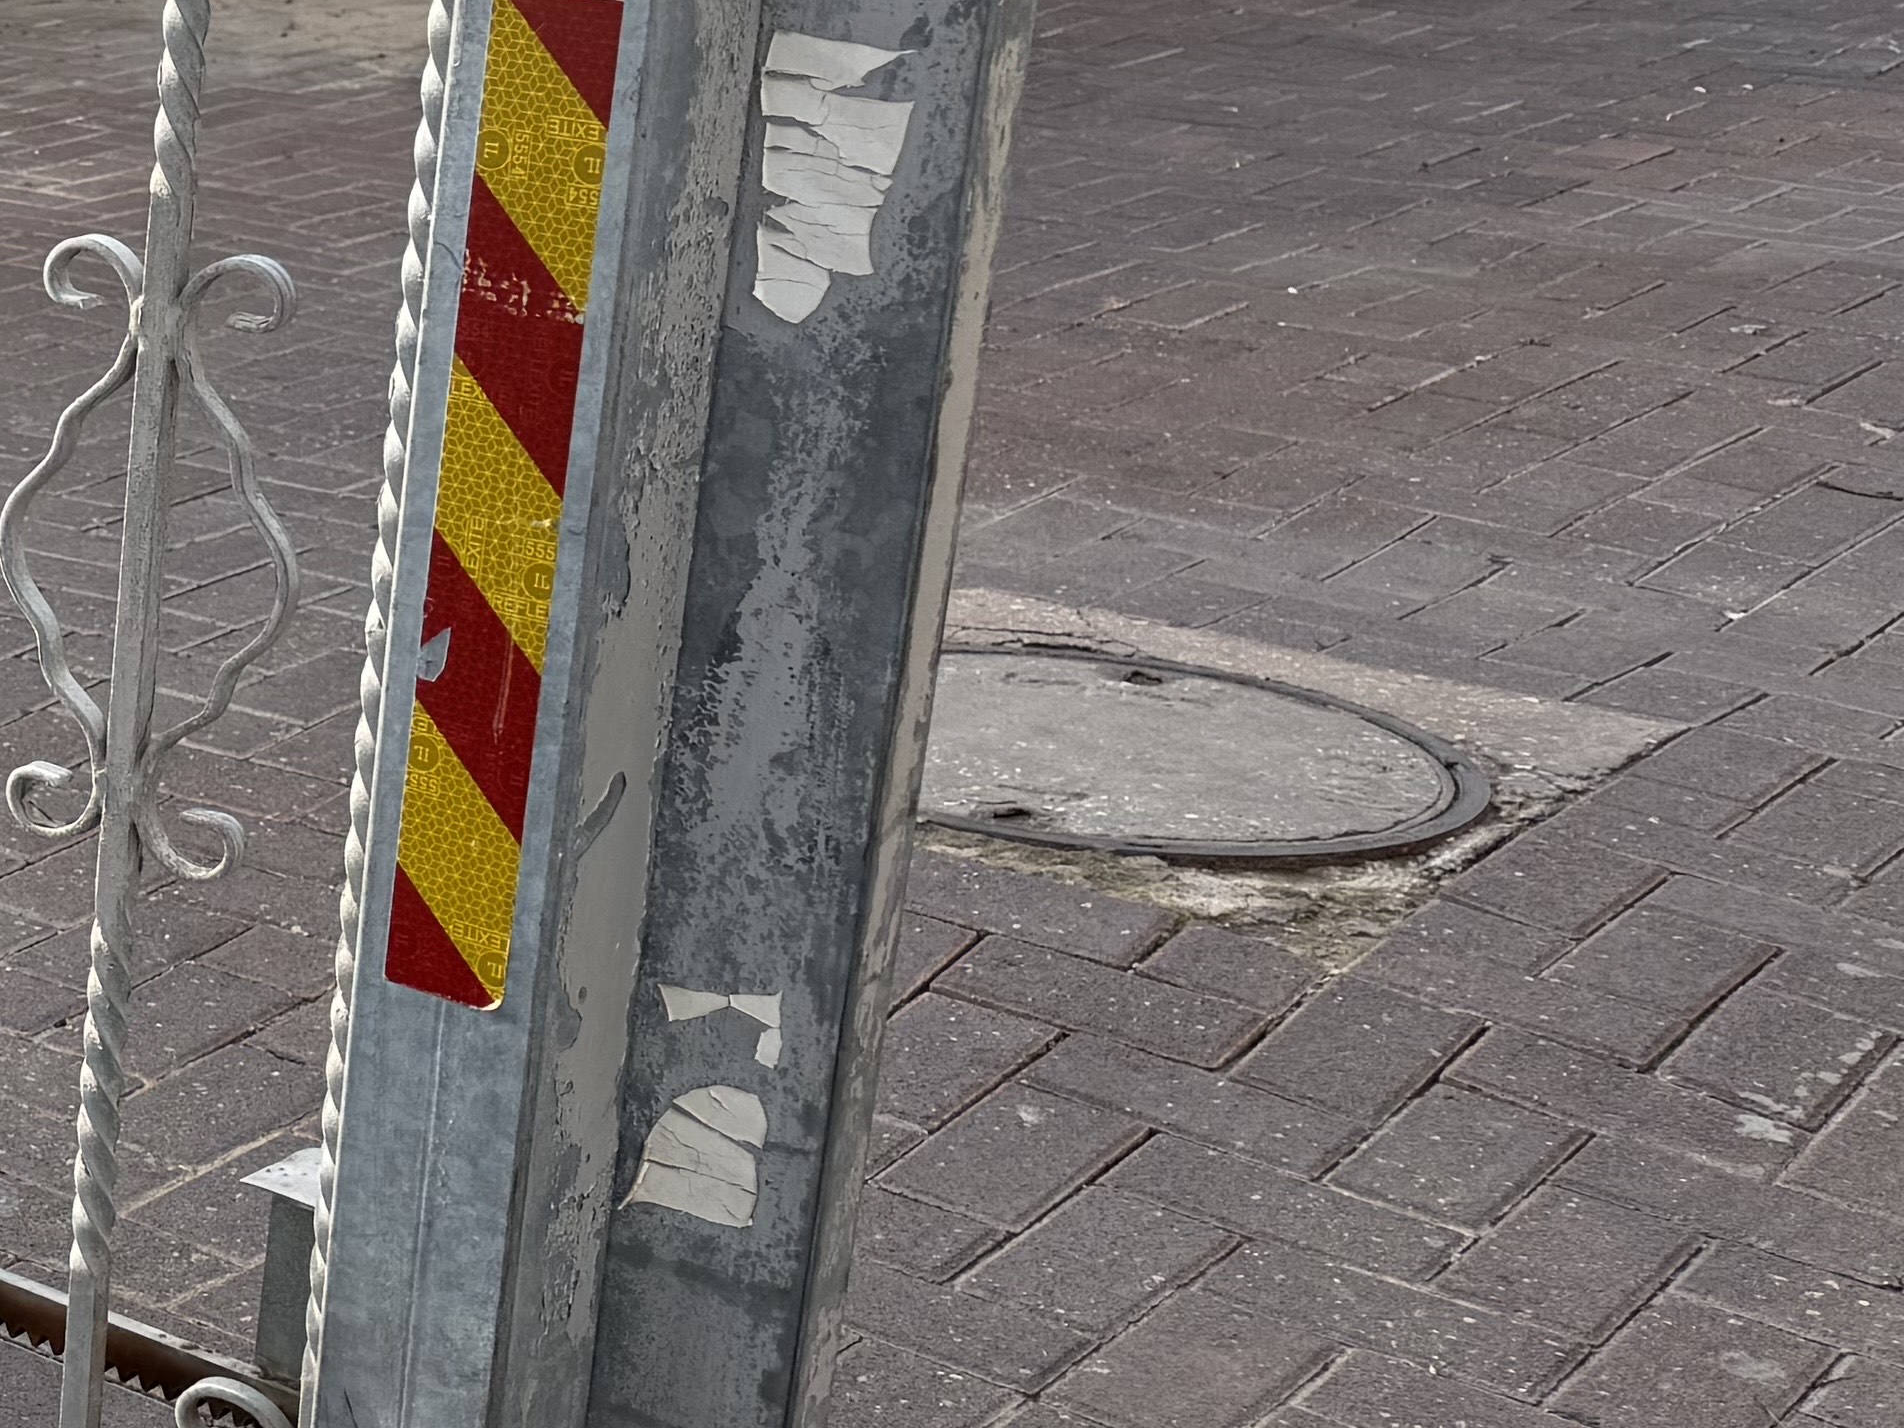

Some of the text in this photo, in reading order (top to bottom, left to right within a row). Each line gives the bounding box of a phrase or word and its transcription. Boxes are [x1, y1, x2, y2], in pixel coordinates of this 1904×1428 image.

[546, 118, 599, 141] EXITE
[484, 141, 499, 159] IL
[511, 132, 530, 180] 5554
[584, 156, 601, 174] IL
[534, 572, 550, 590] IL
